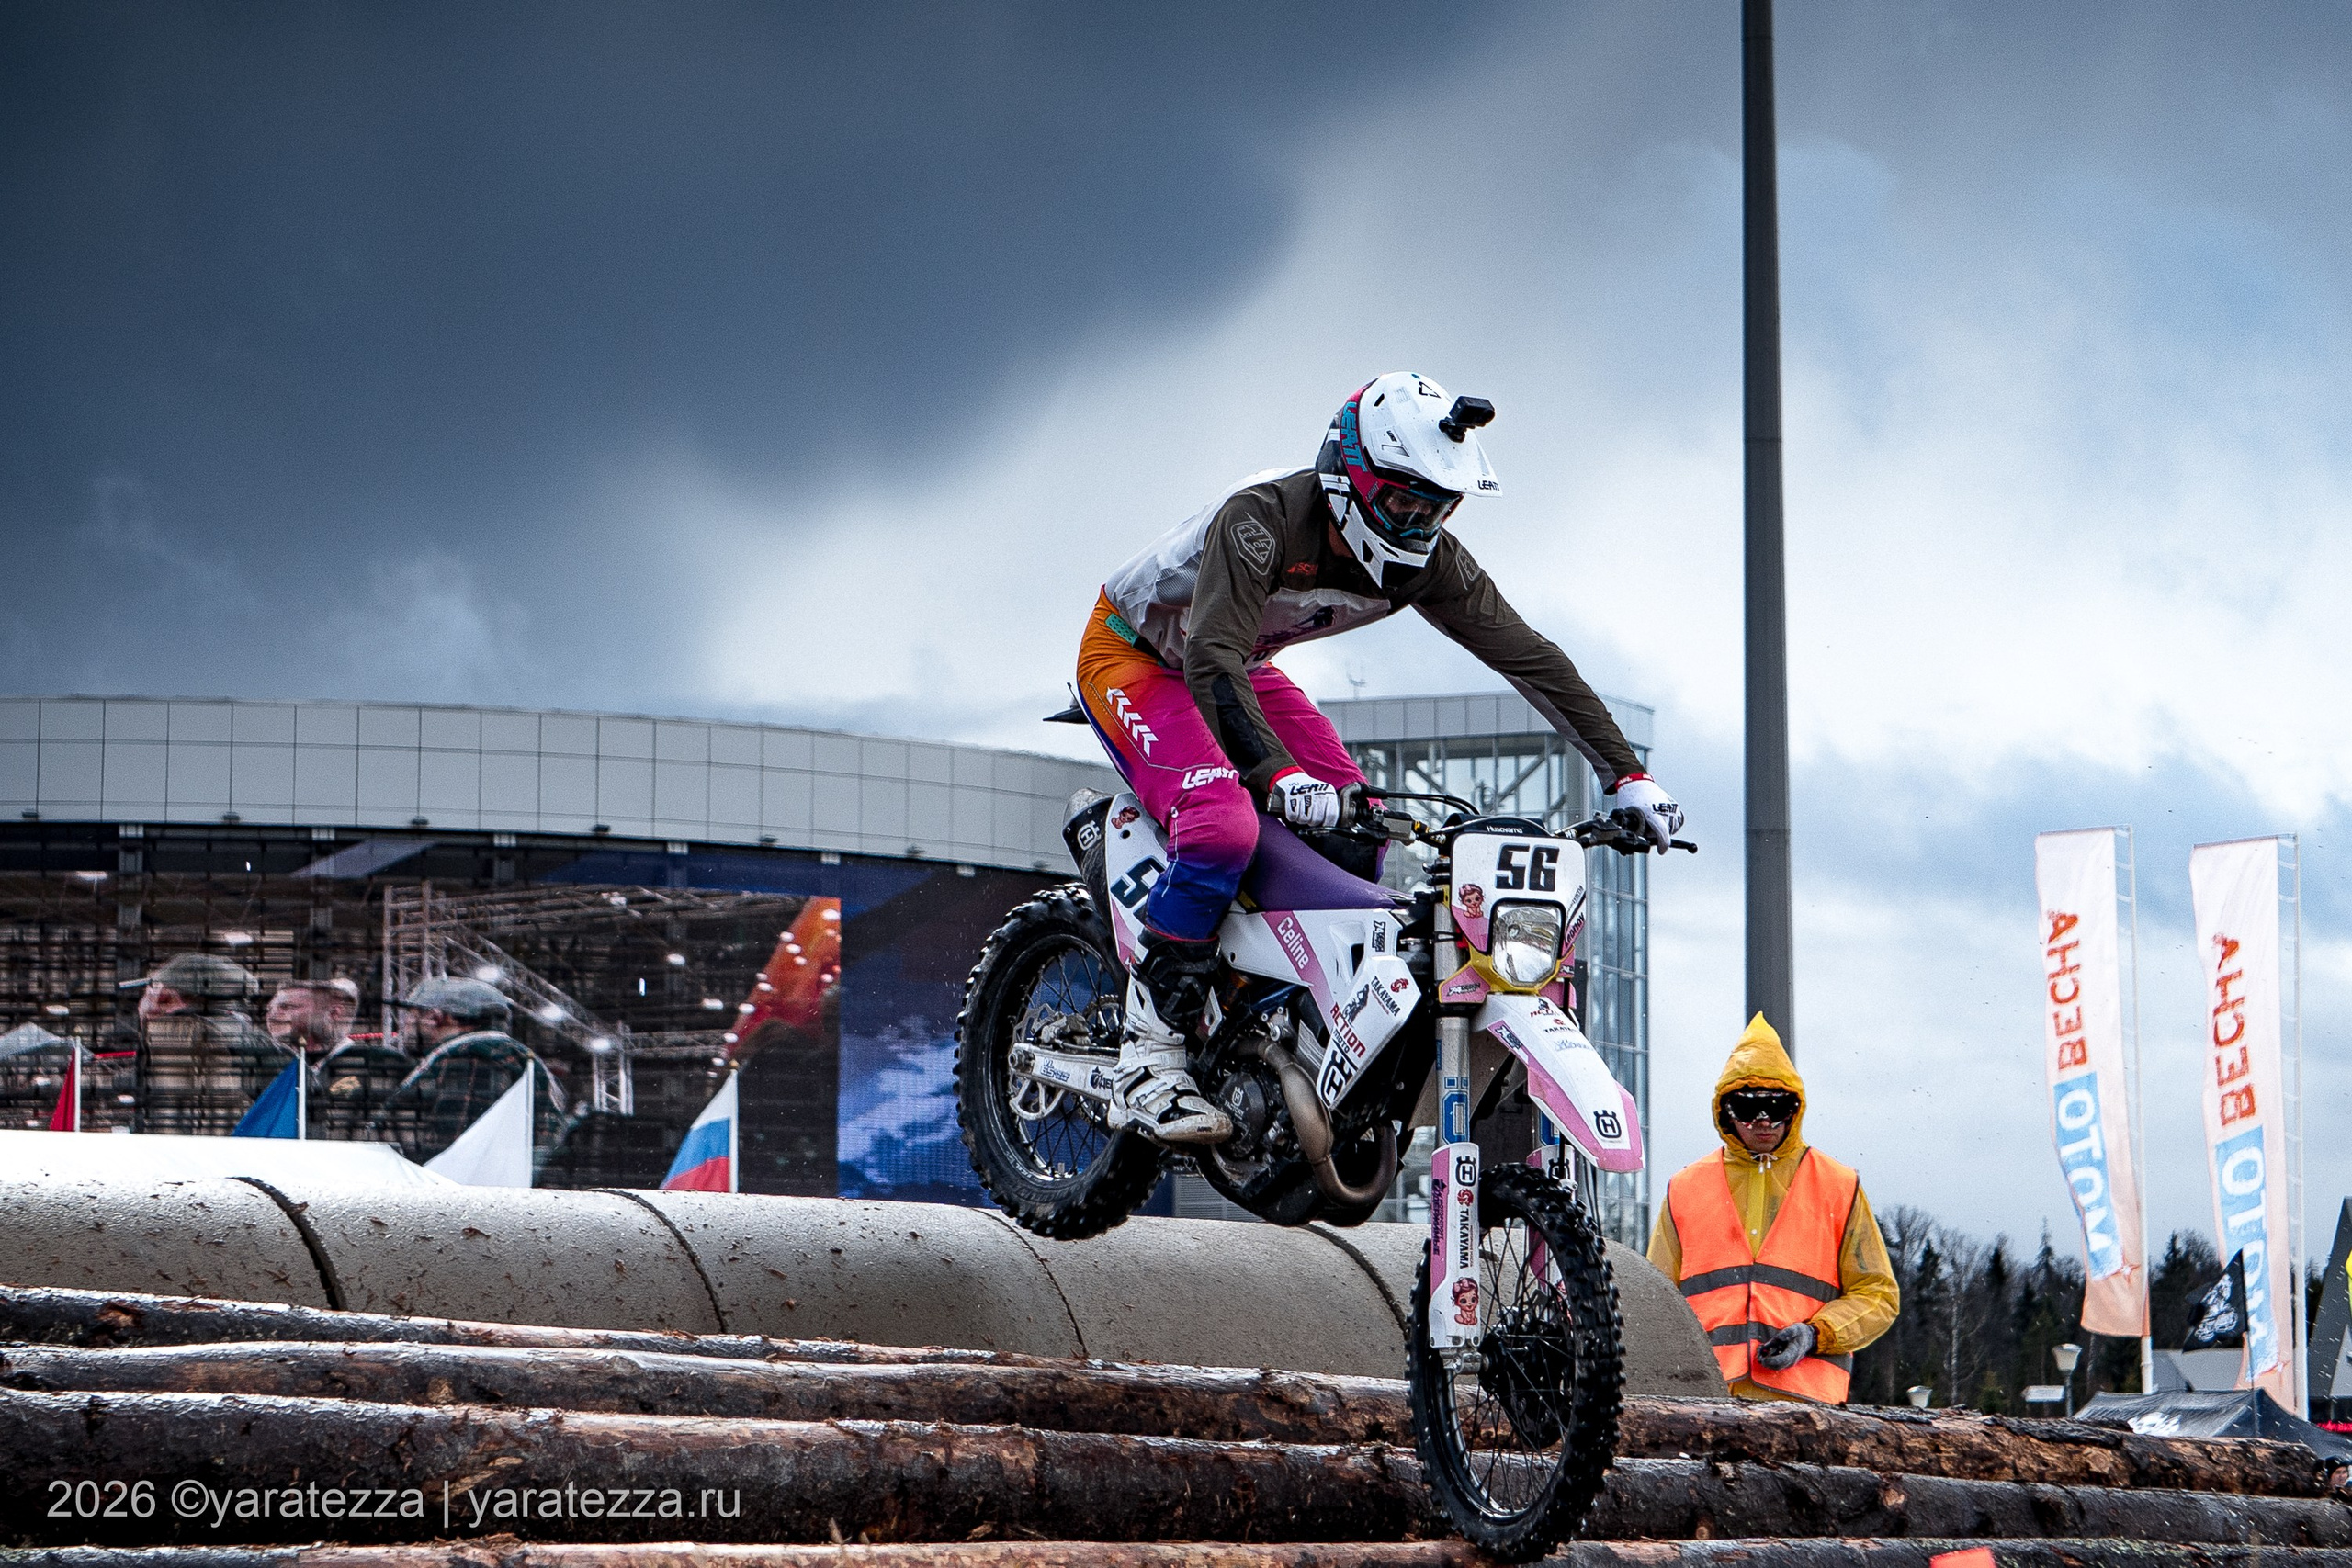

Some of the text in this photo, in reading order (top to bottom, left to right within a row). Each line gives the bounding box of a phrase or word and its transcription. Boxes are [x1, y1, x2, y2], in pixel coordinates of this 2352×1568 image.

[1340, 401, 1368, 472] LEATT
[1477, 479, 1500, 491] LEATT
[1182, 766, 1238, 790] LEATT
[1289, 782, 1329, 796] LEATT
[1652, 803, 1678, 815] LEATT
[1495, 842, 1560, 892] 56
[1277, 916, 1309, 969] Celine
[1370, 976, 1401, 1017] TAKAYAMA
[1330, 1001, 1366, 1058] ACTION
[1459, 1208, 1471, 1269] TAKAYAMA
